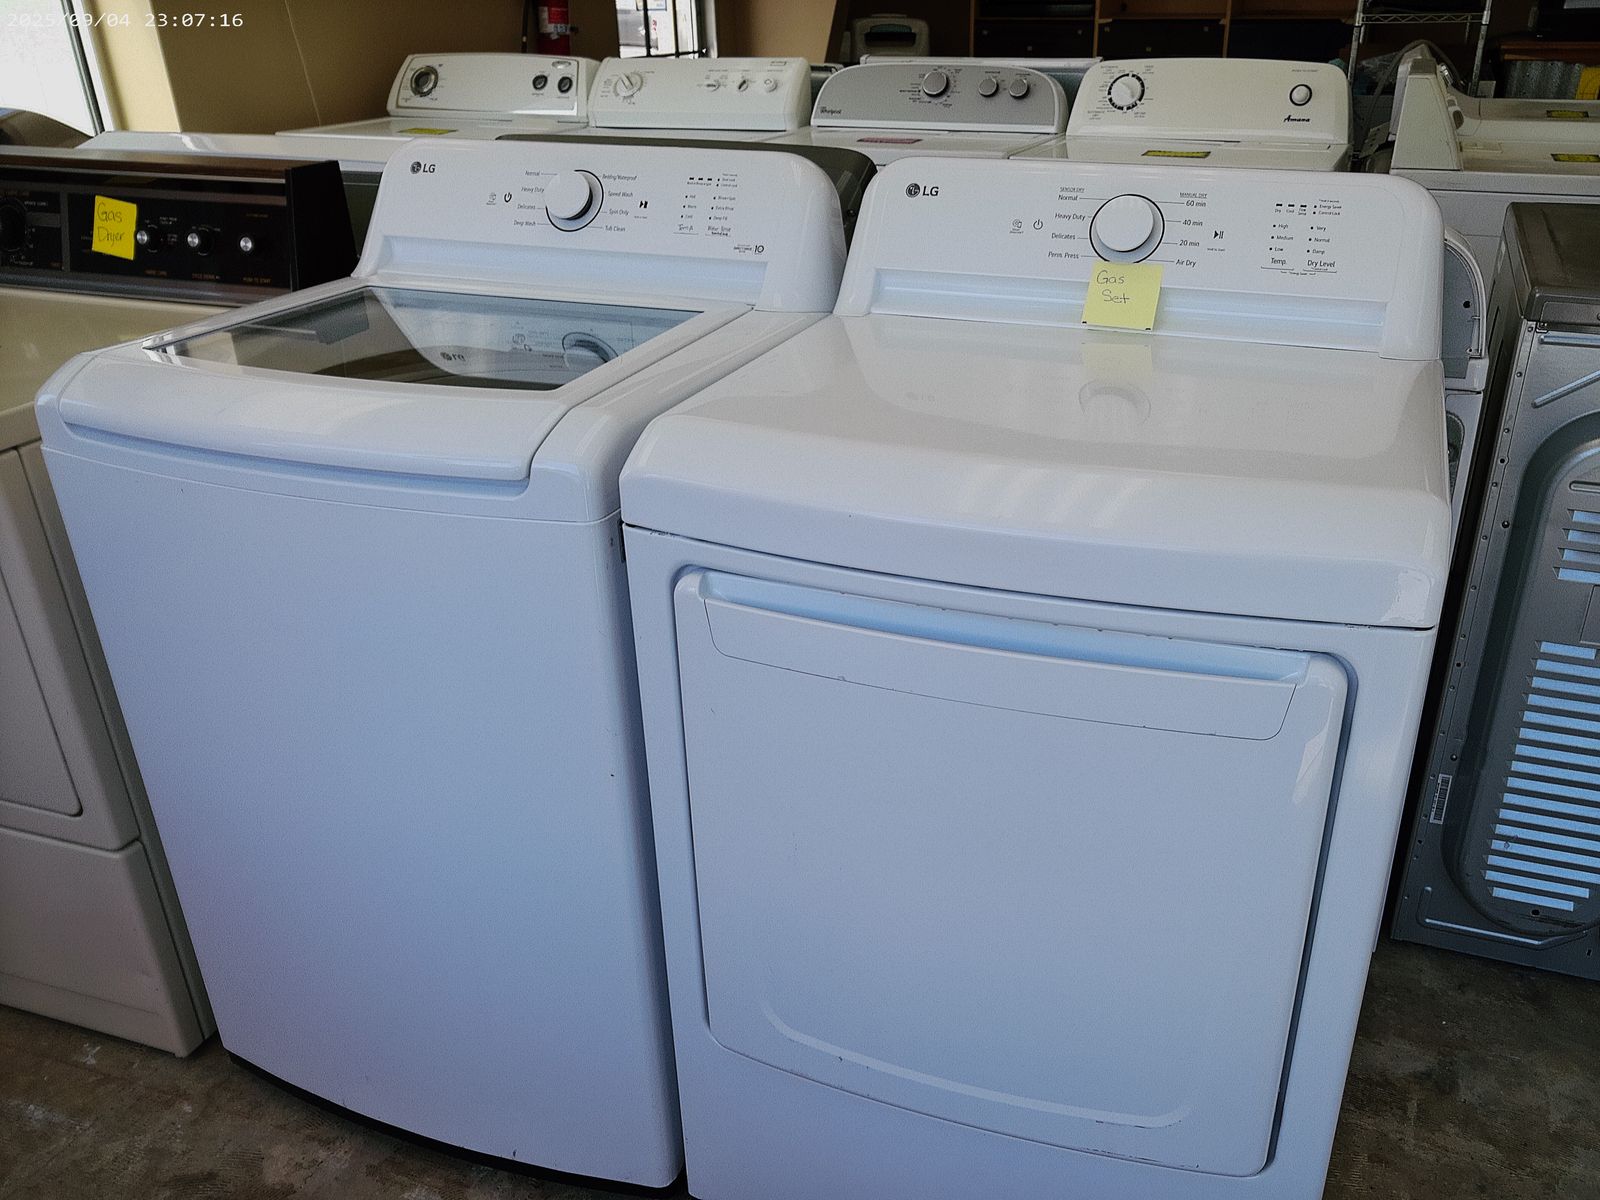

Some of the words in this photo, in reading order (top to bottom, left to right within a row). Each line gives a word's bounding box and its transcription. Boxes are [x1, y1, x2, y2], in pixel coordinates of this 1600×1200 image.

[1283, 115, 1310, 123] Amana
[422, 163, 436, 174] LG
[922, 186, 940, 197] LG
[97, 202, 122, 223] Gas
[97, 226, 125, 247] Dryer
[754, 245, 765, 253] 10
[1096, 269, 1125, 285] Gas
[1102, 289, 1130, 304] Set
